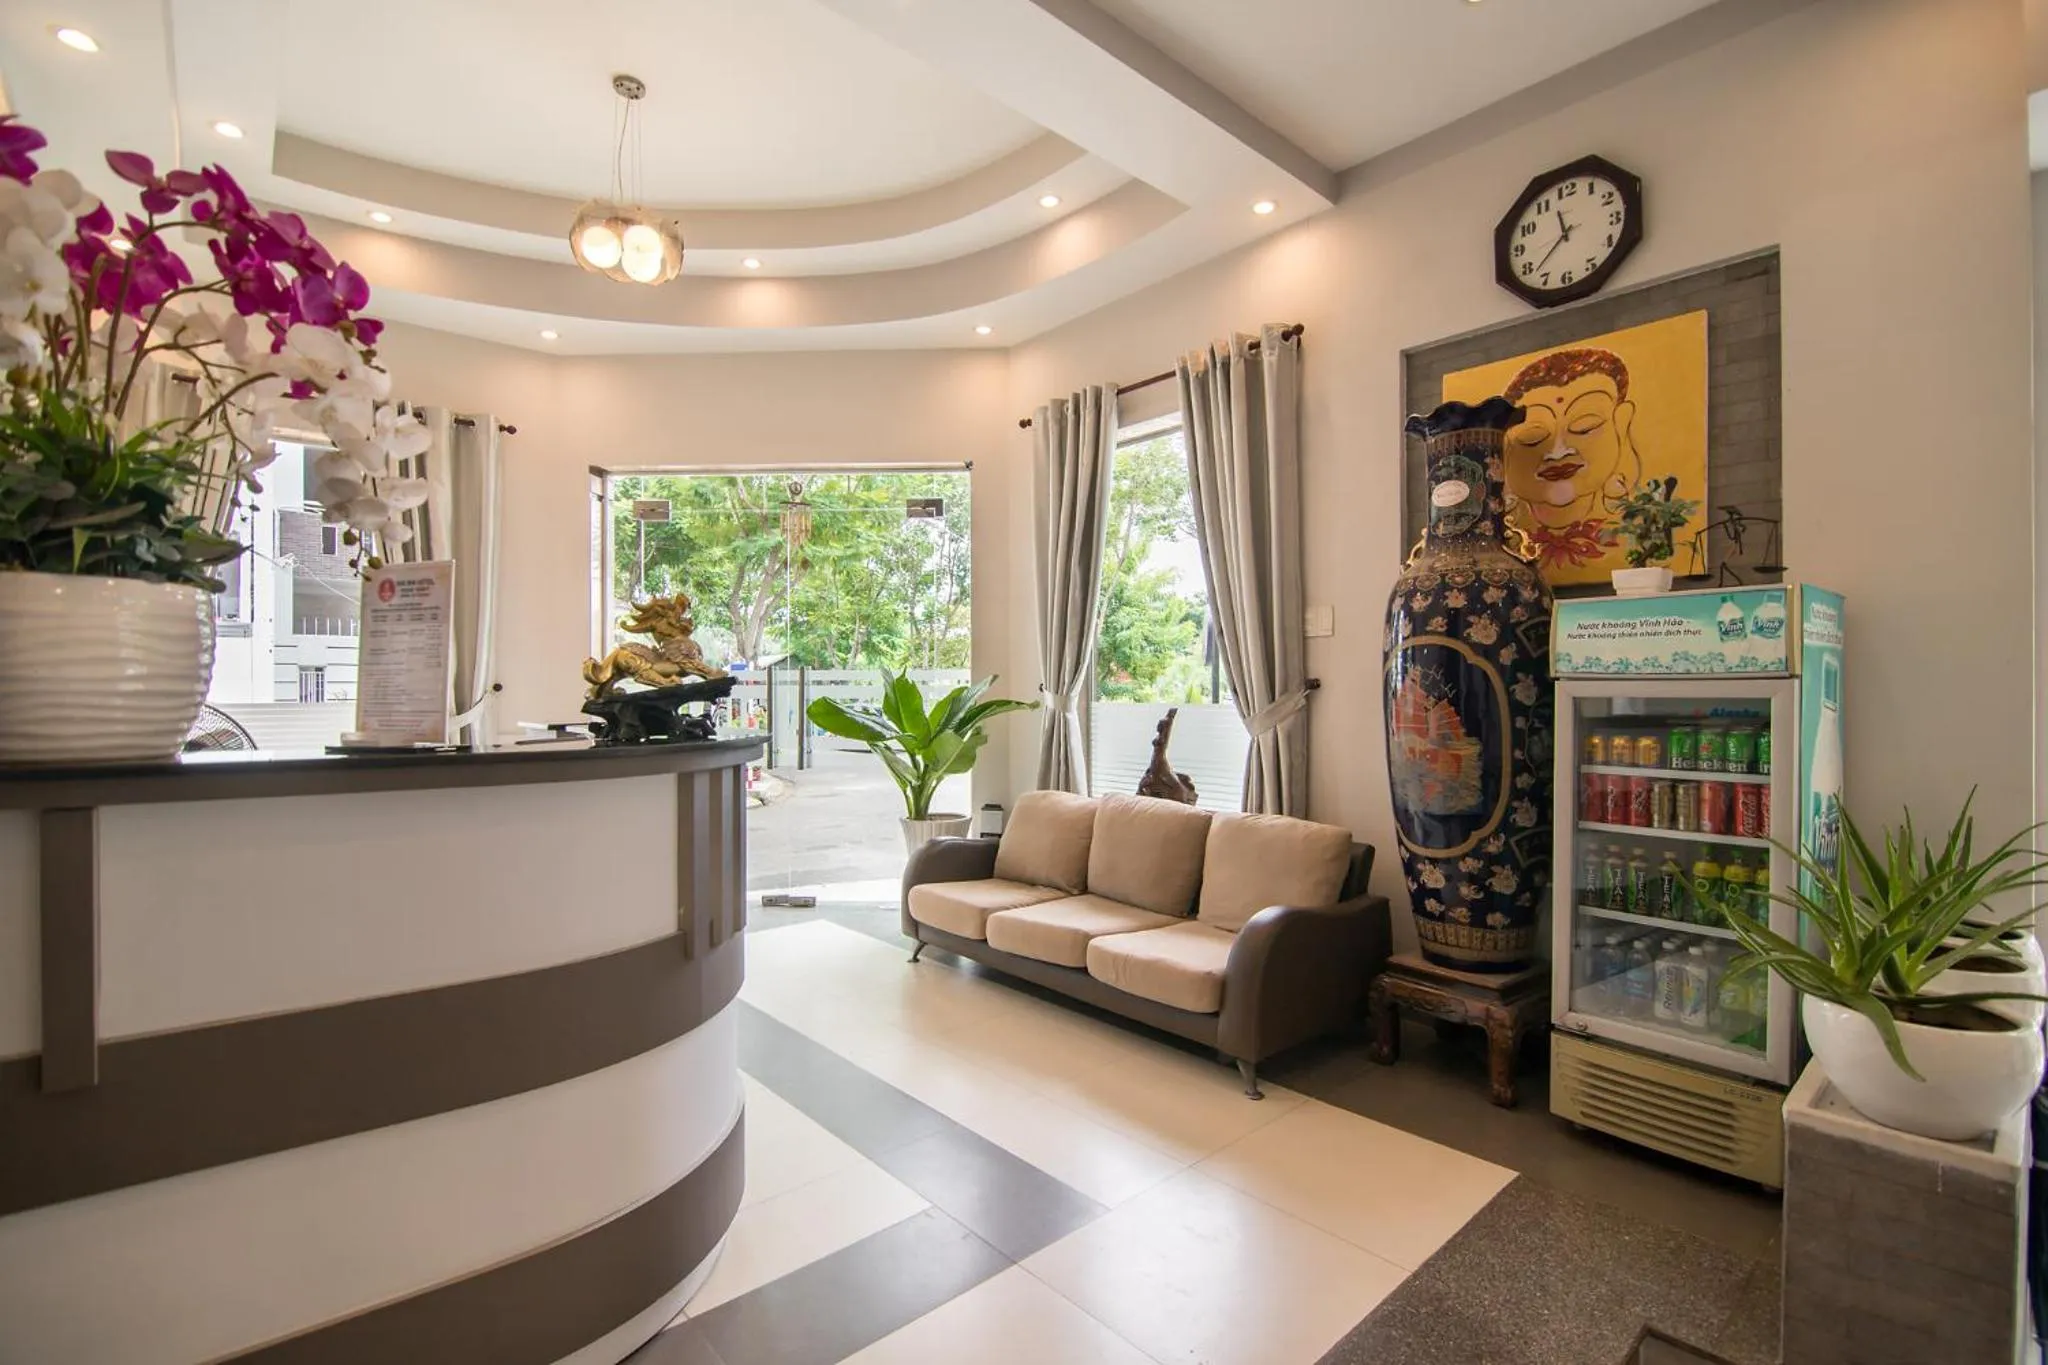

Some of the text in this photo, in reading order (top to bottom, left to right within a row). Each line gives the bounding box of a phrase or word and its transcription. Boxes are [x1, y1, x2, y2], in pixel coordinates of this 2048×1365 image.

[1558, 182, 1577, 201] 12
[1588, 181, 1595, 196] 1
[1536, 198, 1550, 216] 11
[1601, 191, 1615, 207] 2
[1609, 210, 1622, 226] 3
[1521, 221, 1537, 238] 10
[1514, 244, 1526, 258] 9
[1521, 261, 1534, 276] 8
[1585, 256, 1598, 273] 5
[1540, 271, 1551, 287] 7
[1561, 270, 1574, 286] 6
